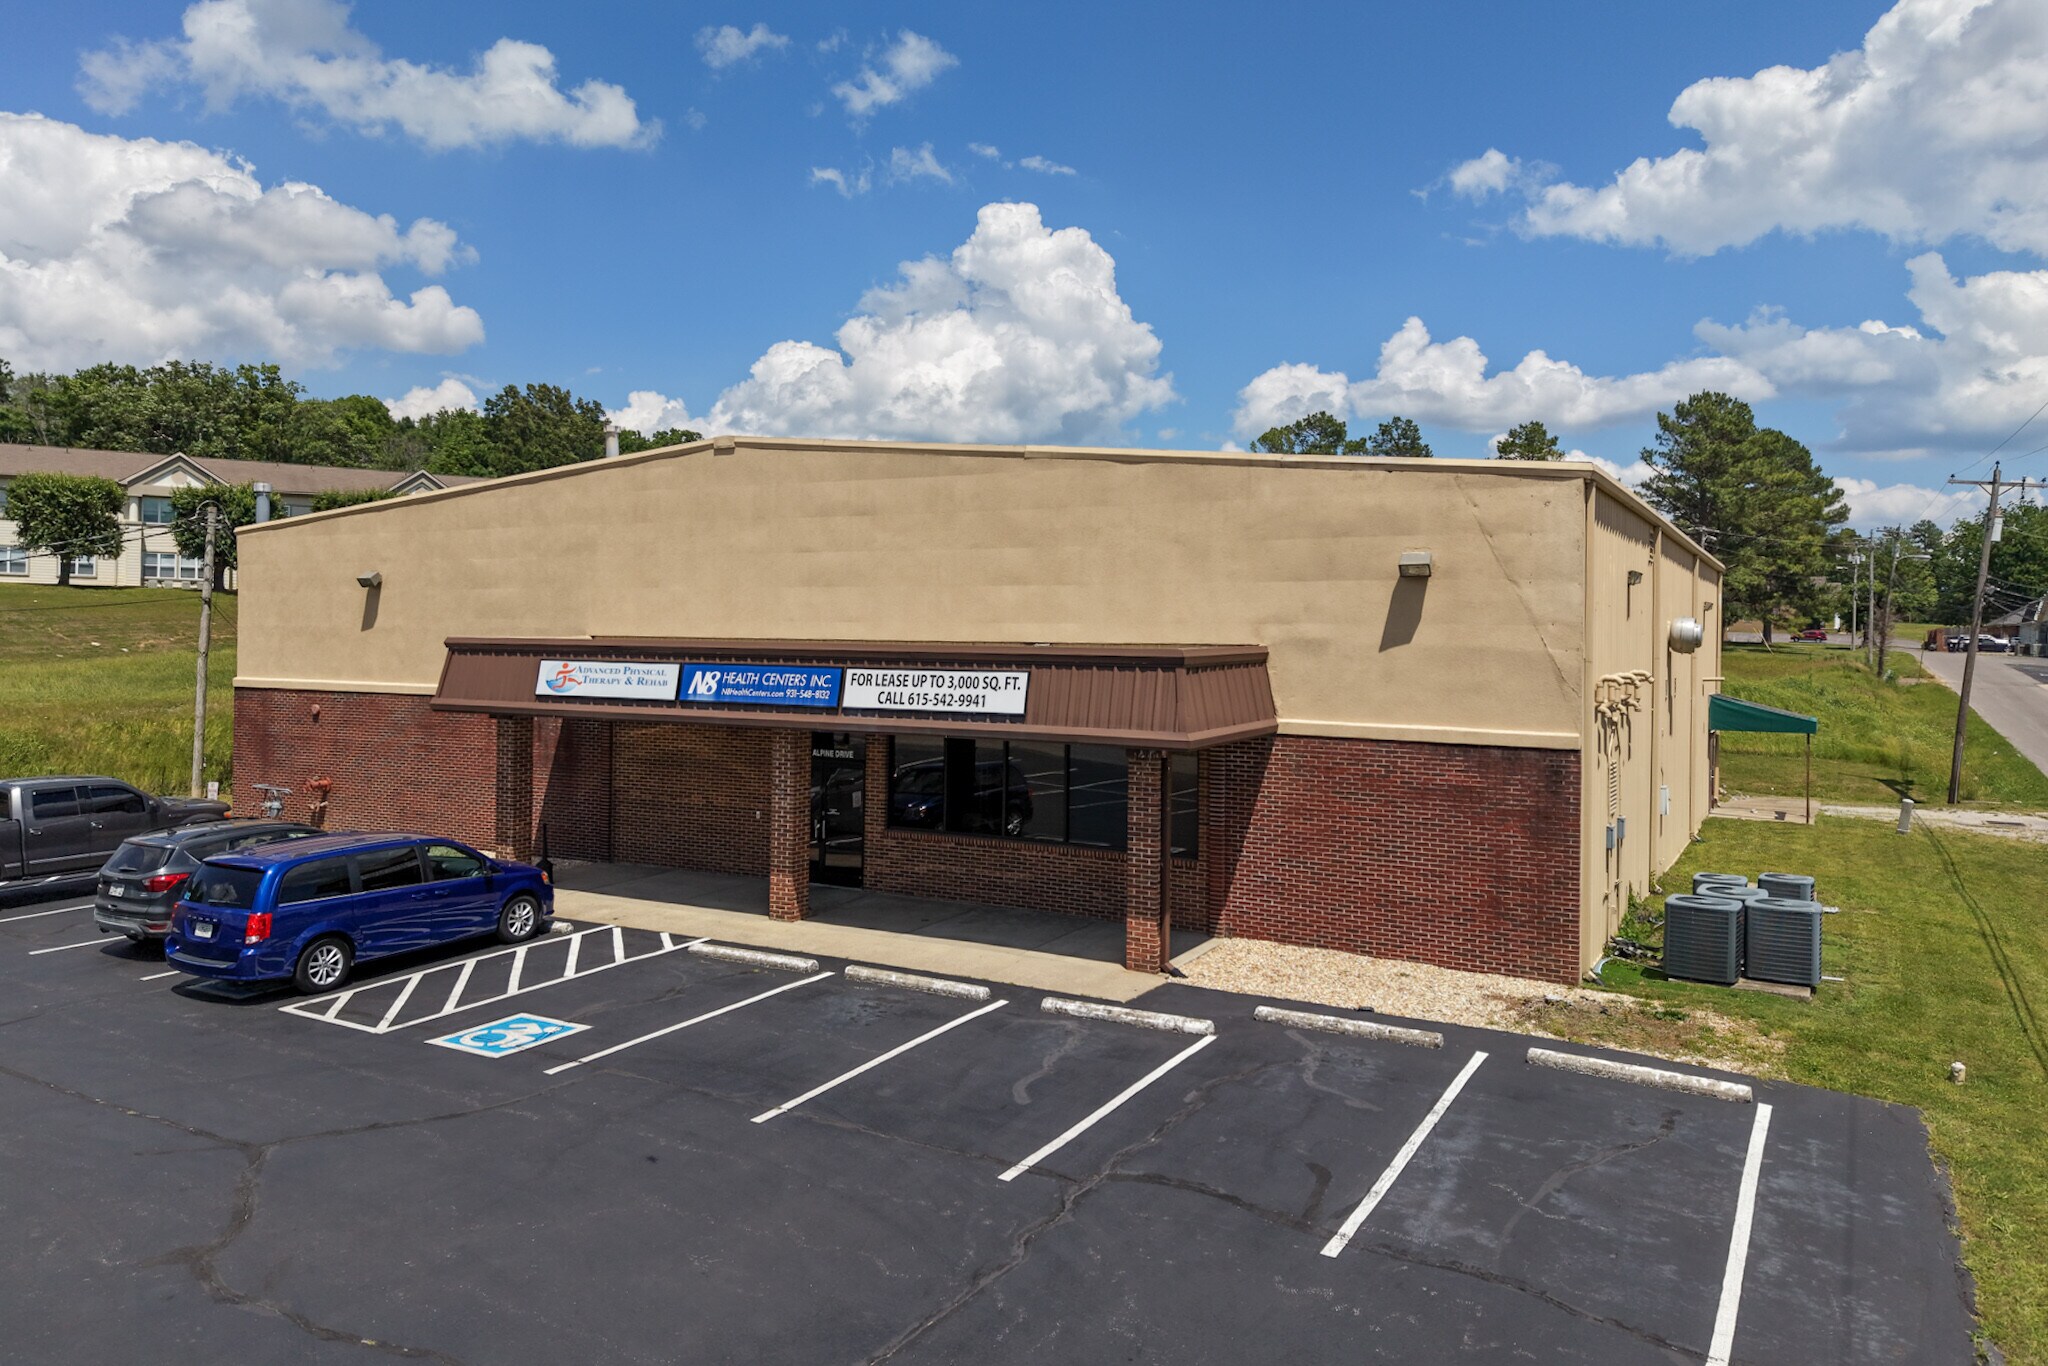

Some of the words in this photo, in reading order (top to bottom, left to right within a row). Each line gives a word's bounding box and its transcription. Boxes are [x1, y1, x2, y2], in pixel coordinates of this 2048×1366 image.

[577, 665, 620, 674] ADVANCED
[623, 666, 667, 676] PHYSICAL
[582, 675, 621, 685] THERAPY
[624, 677, 634, 685] &
[637, 677, 668, 687] REHAB
[722, 672, 760, 685] HEALTH
[762, 673, 807, 686] CENTERS
[810, 674, 832, 688] INC.
[850, 673, 873, 686] FOR
[875, 674, 909, 687] LEASE
[912, 675, 927, 688] UP
[930, 675, 945, 688] TO
[947, 676, 980, 691] 3,000
[982, 676, 1001, 691] SQ.
[1004, 677, 1021, 690] FT.
[877, 691, 905, 705] CALL
[907, 693, 986, 707] 615-542-9941
[812, 748, 834, 758] ALPINE
[835, 750, 854, 759] DRIVE
